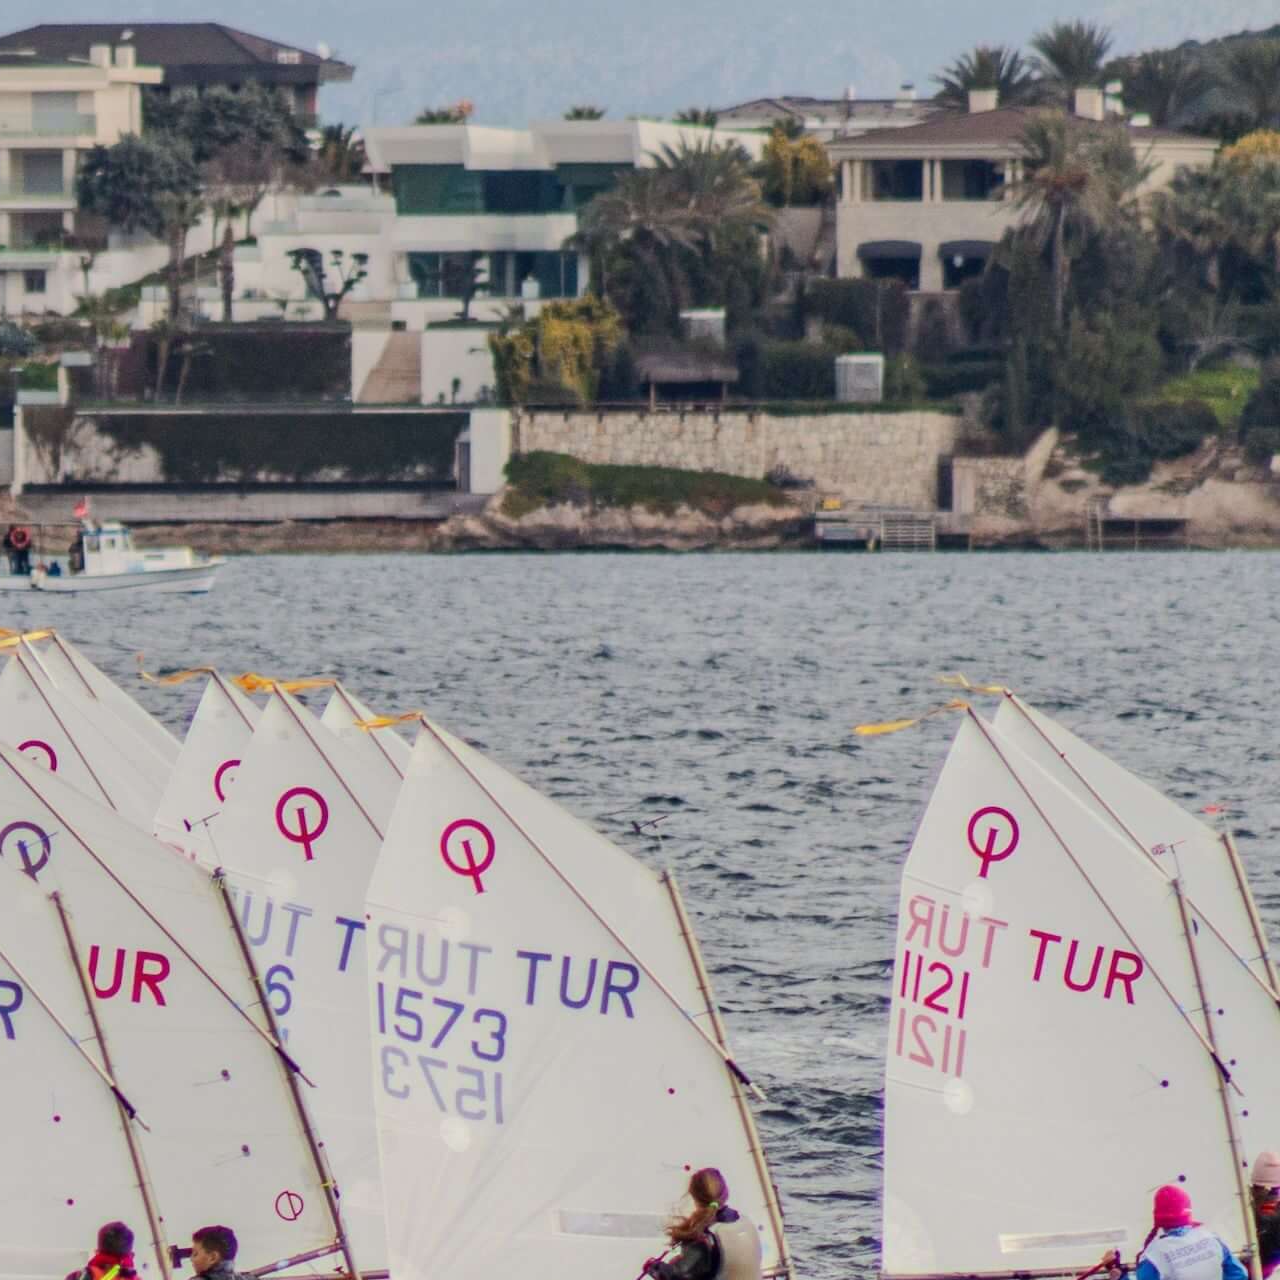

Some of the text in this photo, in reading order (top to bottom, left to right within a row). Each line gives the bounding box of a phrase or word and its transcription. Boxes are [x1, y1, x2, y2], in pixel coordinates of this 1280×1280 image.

[516, 950, 641, 1018] TUR
[900, 950, 970, 1019] 1121
[1029, 929, 1145, 1005] TUR
[377, 981, 508, 1063] 1573
